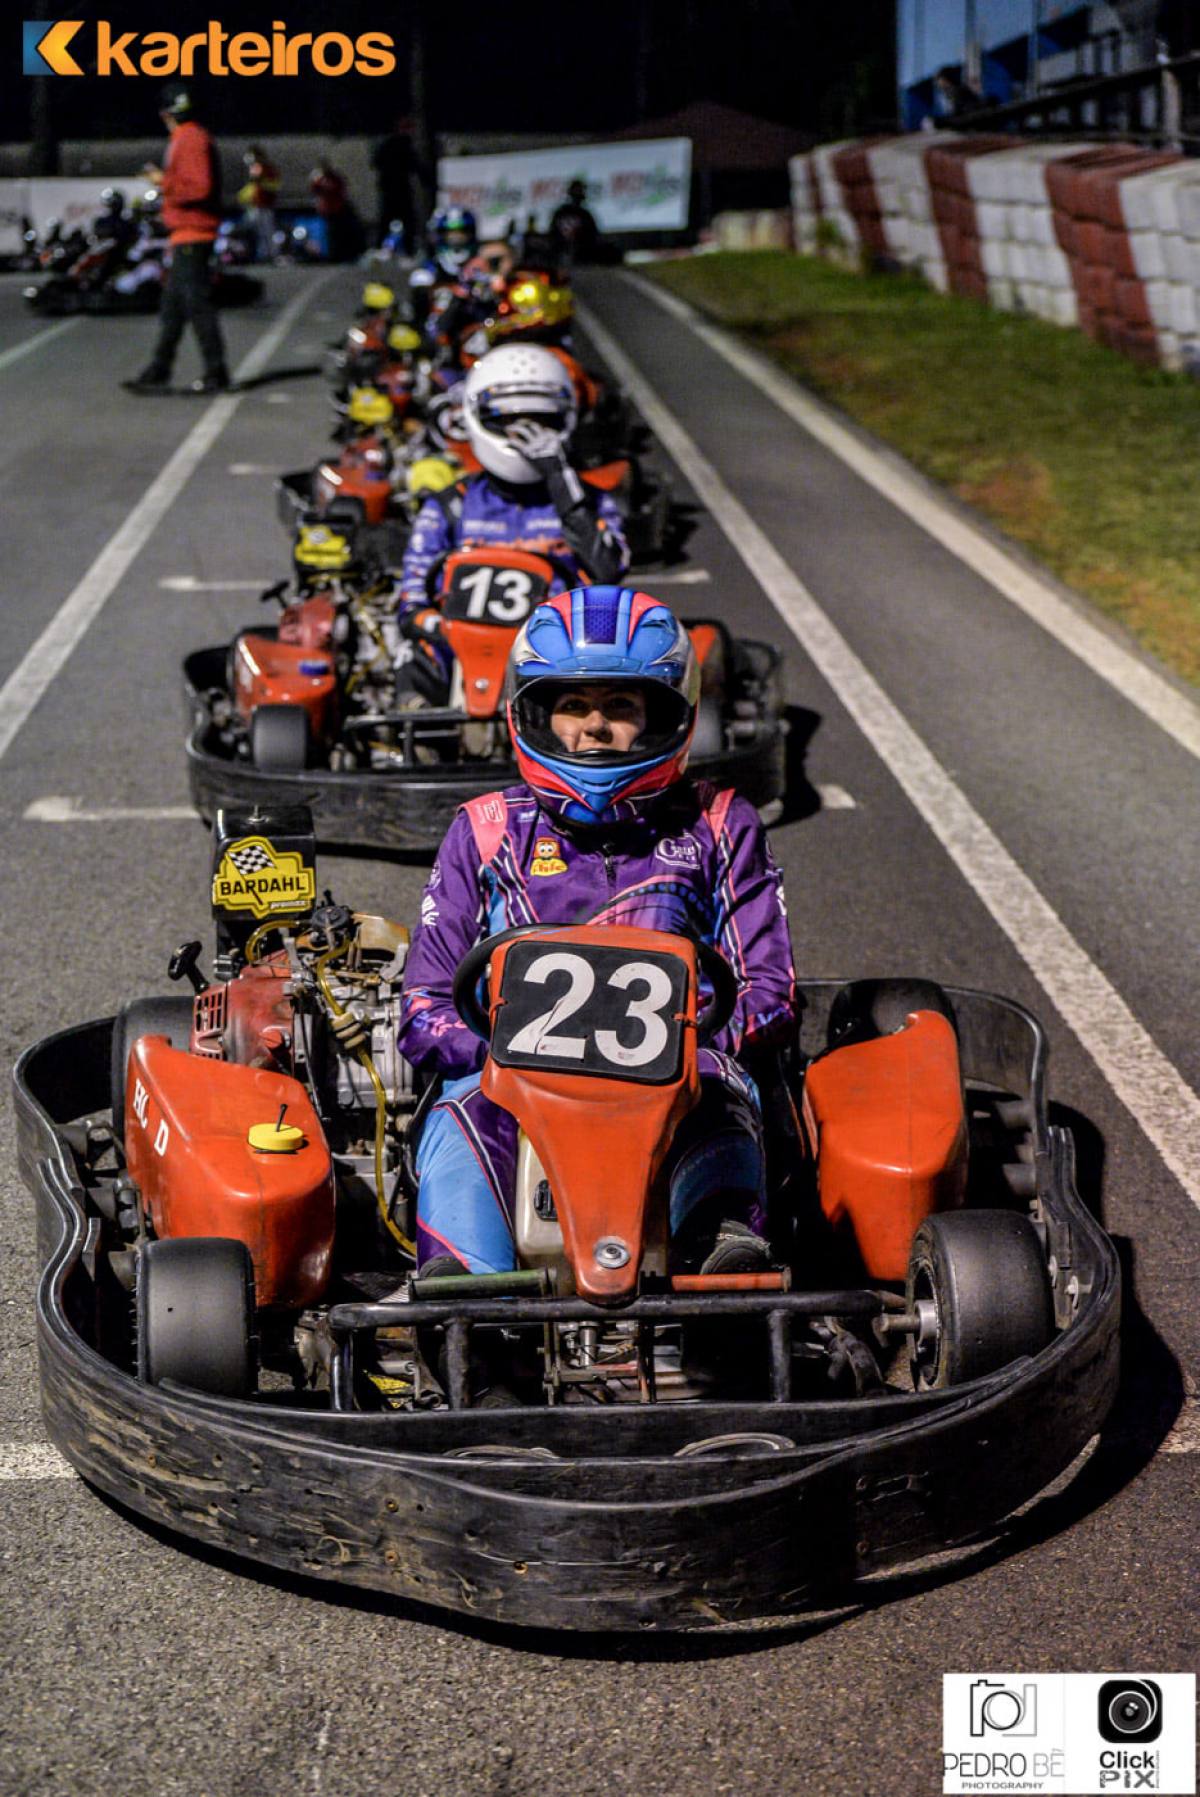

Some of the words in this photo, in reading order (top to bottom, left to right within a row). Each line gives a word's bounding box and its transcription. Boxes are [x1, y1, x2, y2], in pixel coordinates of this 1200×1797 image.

[459, 566, 534, 622] 13
[220, 876, 306, 896] BARDAHL
[507, 952, 673, 1067] 23
